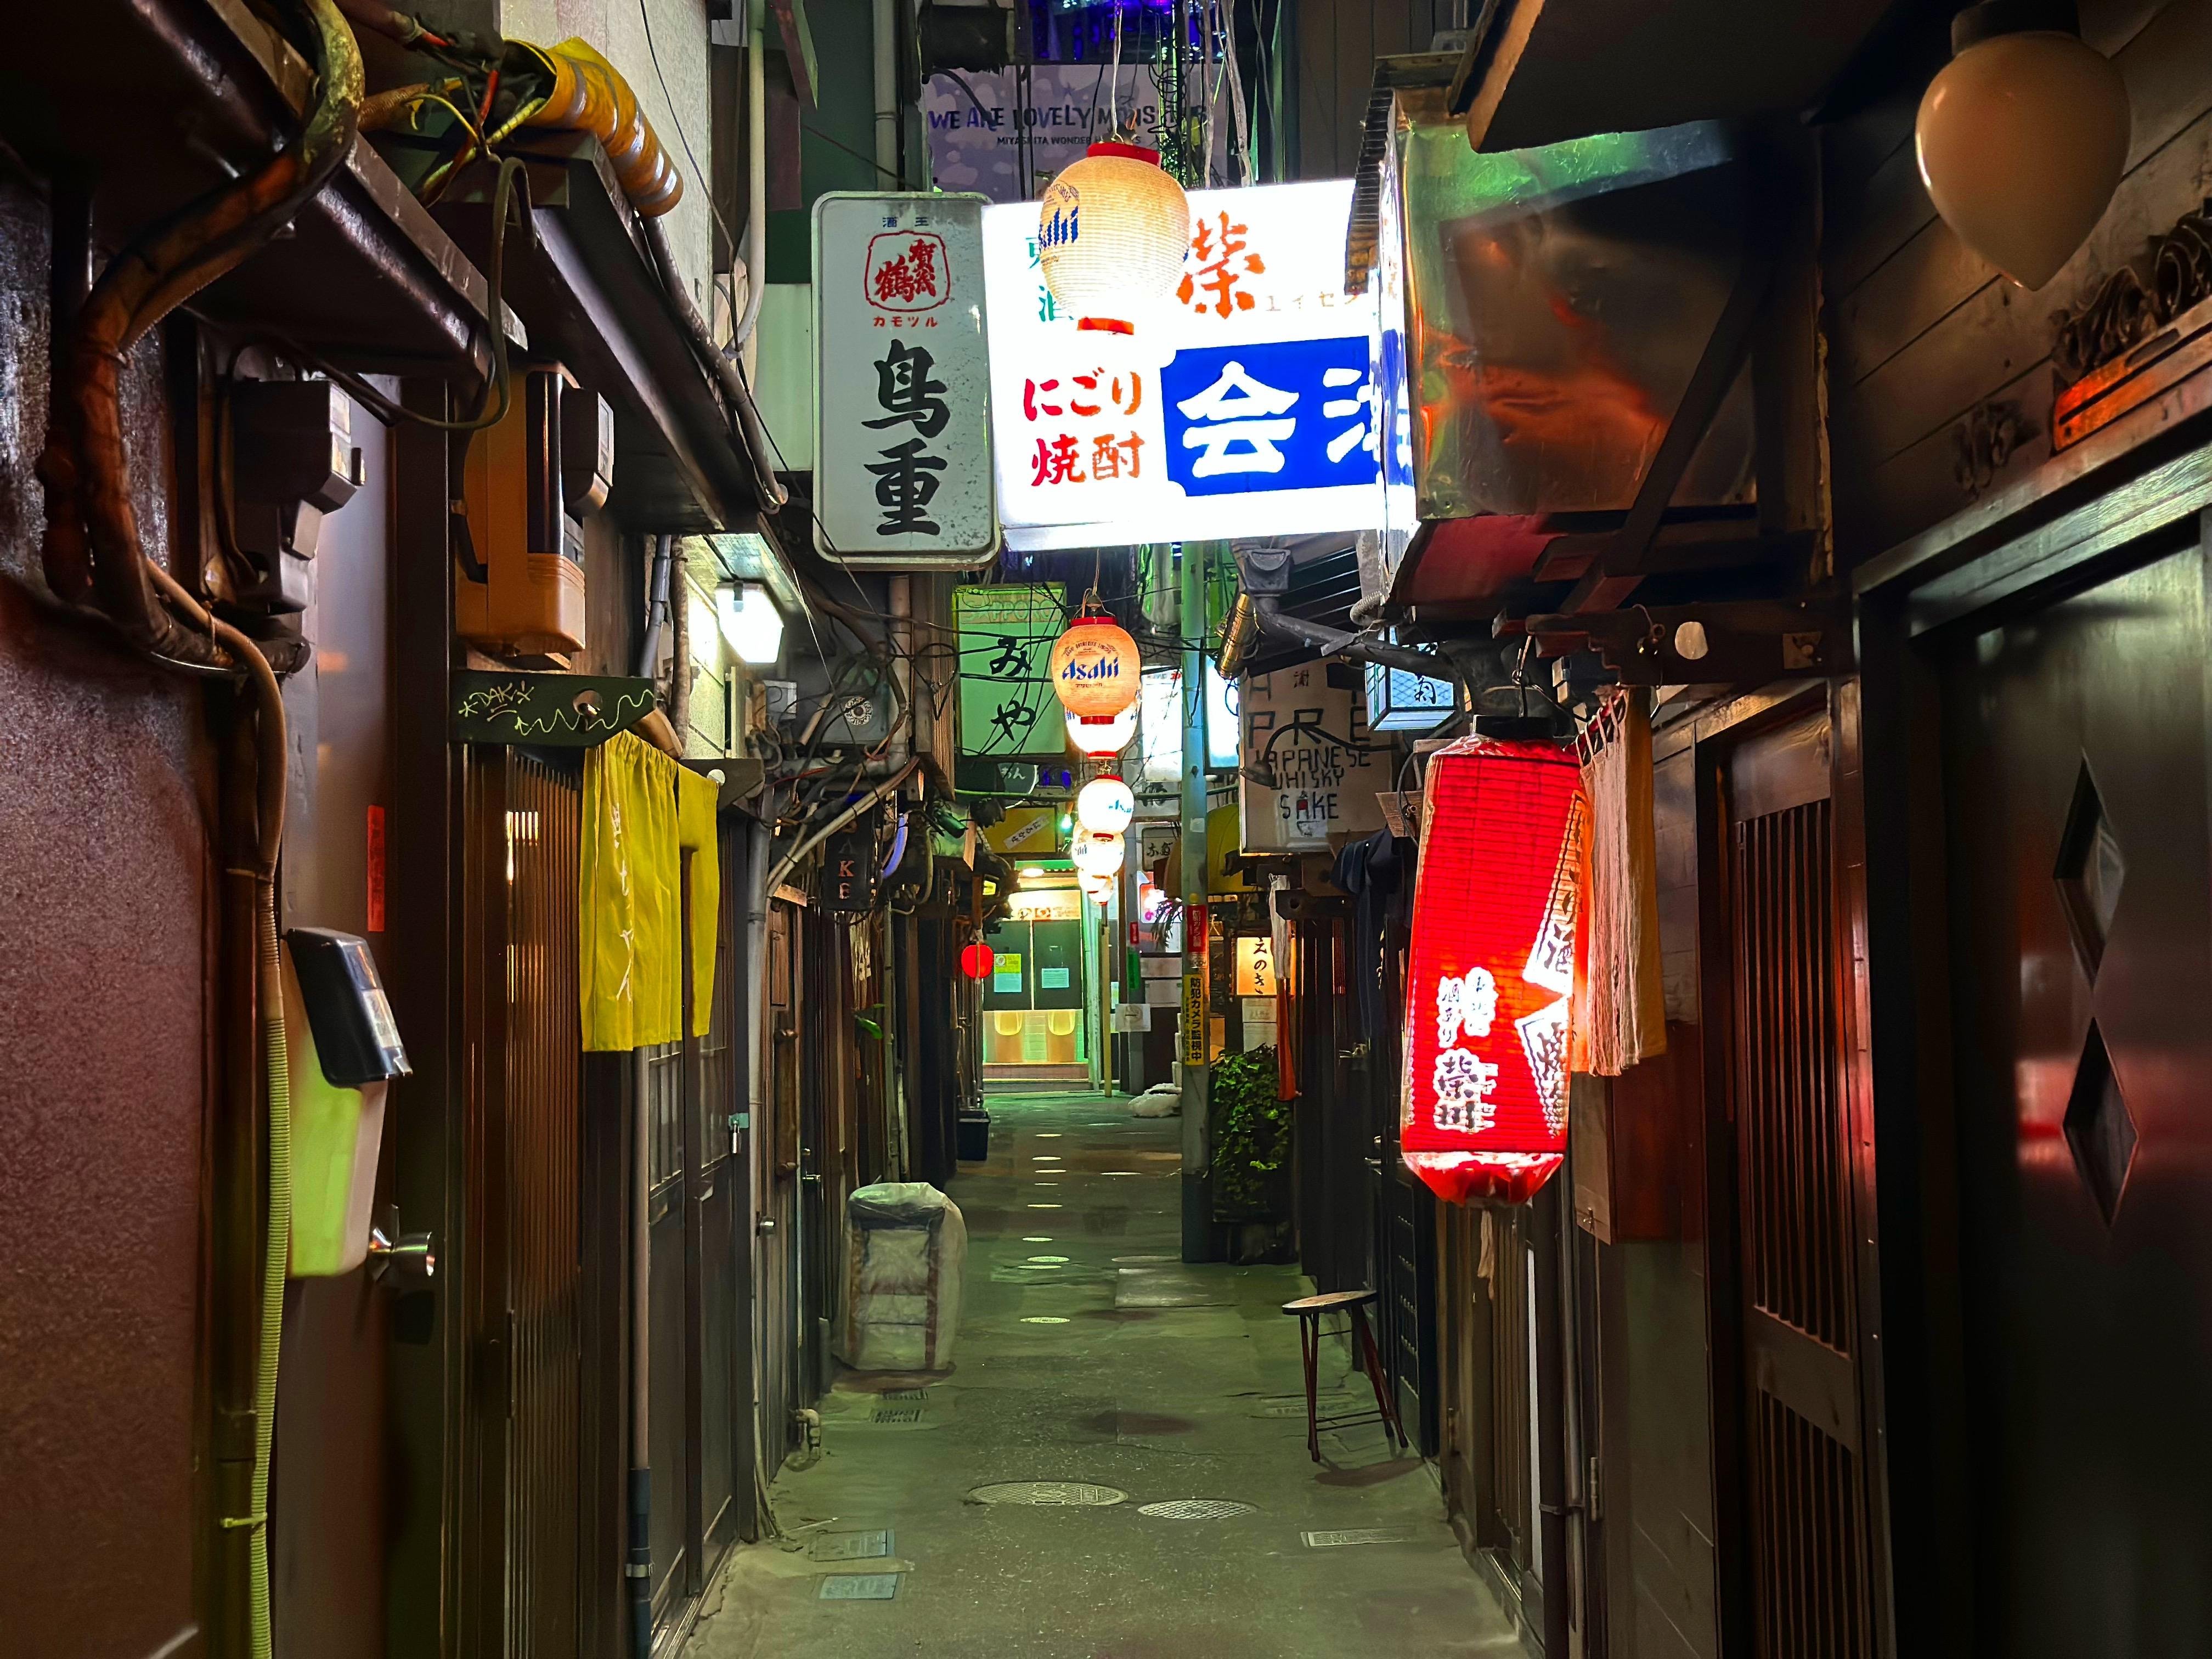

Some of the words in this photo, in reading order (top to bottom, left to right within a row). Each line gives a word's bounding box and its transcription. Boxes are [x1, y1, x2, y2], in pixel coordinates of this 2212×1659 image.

[928, 110, 960, 129] WE
[873, 316, 939, 328] カモツル
[1023, 366, 1142, 422] にごり
[1031, 430, 1146, 487] 焼酎
[1062, 656, 1119, 680] Asahi
[1279, 791, 1339, 820] SAKE
